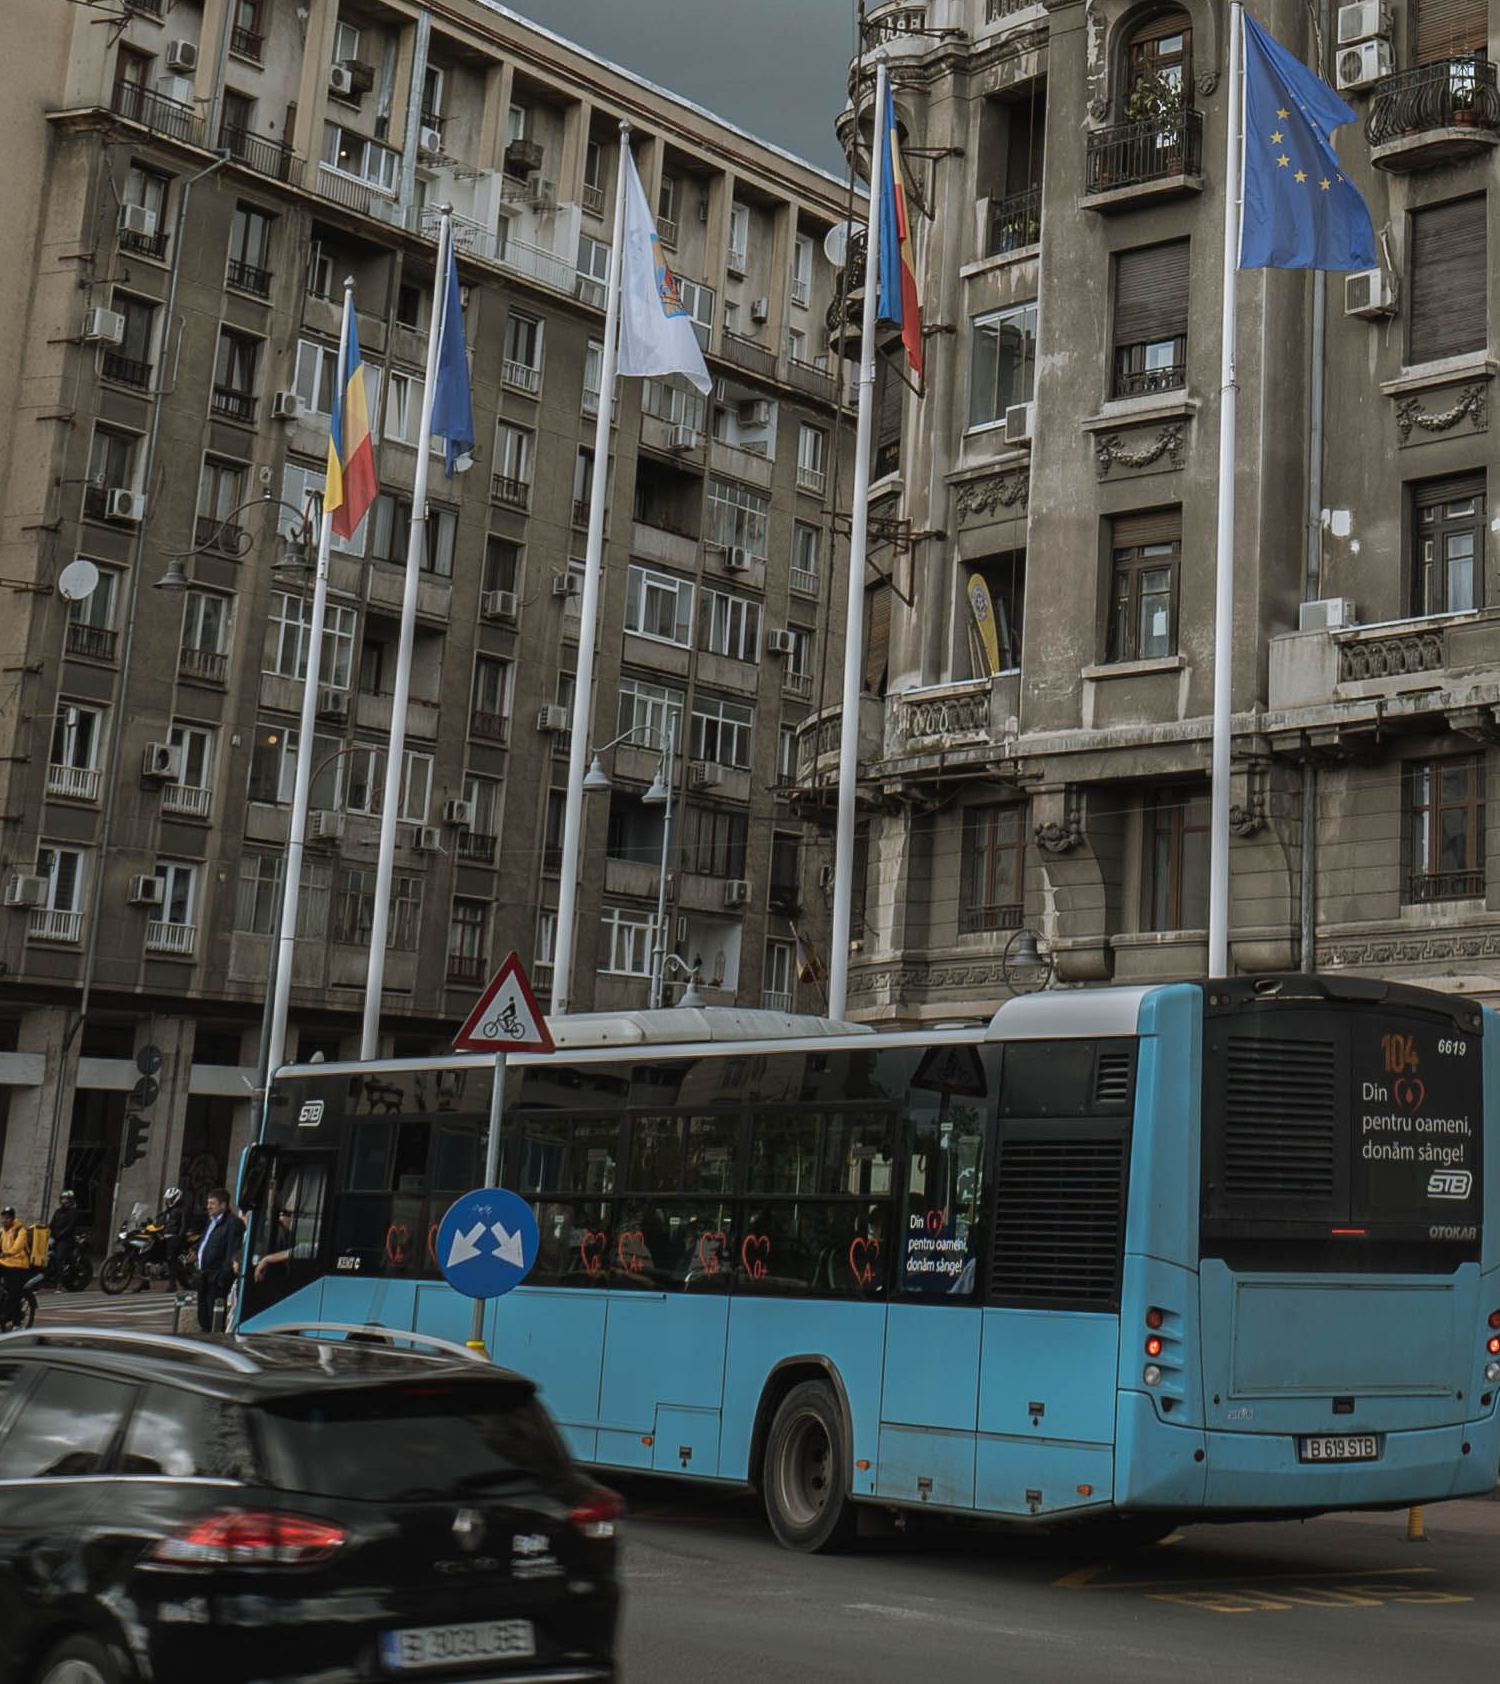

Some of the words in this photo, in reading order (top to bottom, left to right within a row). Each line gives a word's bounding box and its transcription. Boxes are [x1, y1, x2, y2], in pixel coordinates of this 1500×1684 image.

[1381, 1034, 1419, 1073] 104
[1438, 1038, 1466, 1056] 6619
[1362, 1082, 1387, 1101] Din
[299, 1103, 322, 1122] STB
[1362, 1115, 1412, 1134] pentru
[1415, 1117, 1472, 1136] oameni,
[1362, 1139, 1414, 1160] donăm
[1418, 1142, 1465, 1166] sânge!
[1428, 1175, 1468, 1193] STB
[910, 1214, 924, 1229] Din
[1429, 1225, 1477, 1240] OTOKAR
[908, 1237, 933, 1255] pentru
[934, 1237, 968, 1254] oameni,
[907, 1256, 934, 1273] donăm
[935, 1256, 963, 1276] sânge!
[1311, 1439, 1322, 1458] B
[1325, 1438, 1346, 1458] 619
[1347, 1437, 1374, 1456] STB
